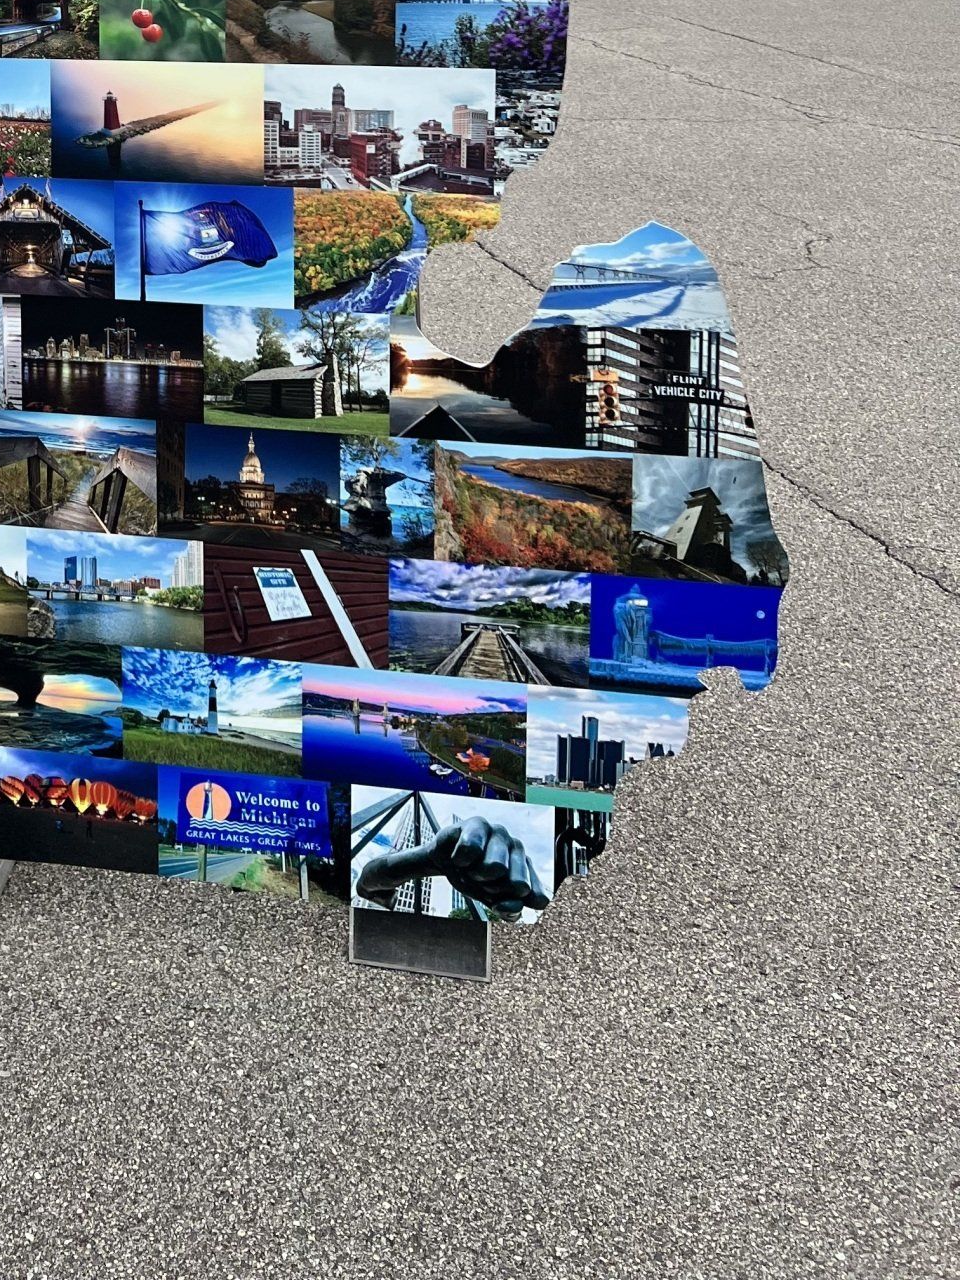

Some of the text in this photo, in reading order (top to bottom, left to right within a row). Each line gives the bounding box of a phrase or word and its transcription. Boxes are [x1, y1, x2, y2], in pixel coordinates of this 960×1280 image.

[672, 375, 704, 385] FLINT
[654, 385, 723, 401] VEHICLE CITY
[235, 790, 321, 812] Welcome to
[241, 808, 317, 831] Michigan
[185, 829, 321, 851] GREAT LAKES GREAT TIMES
